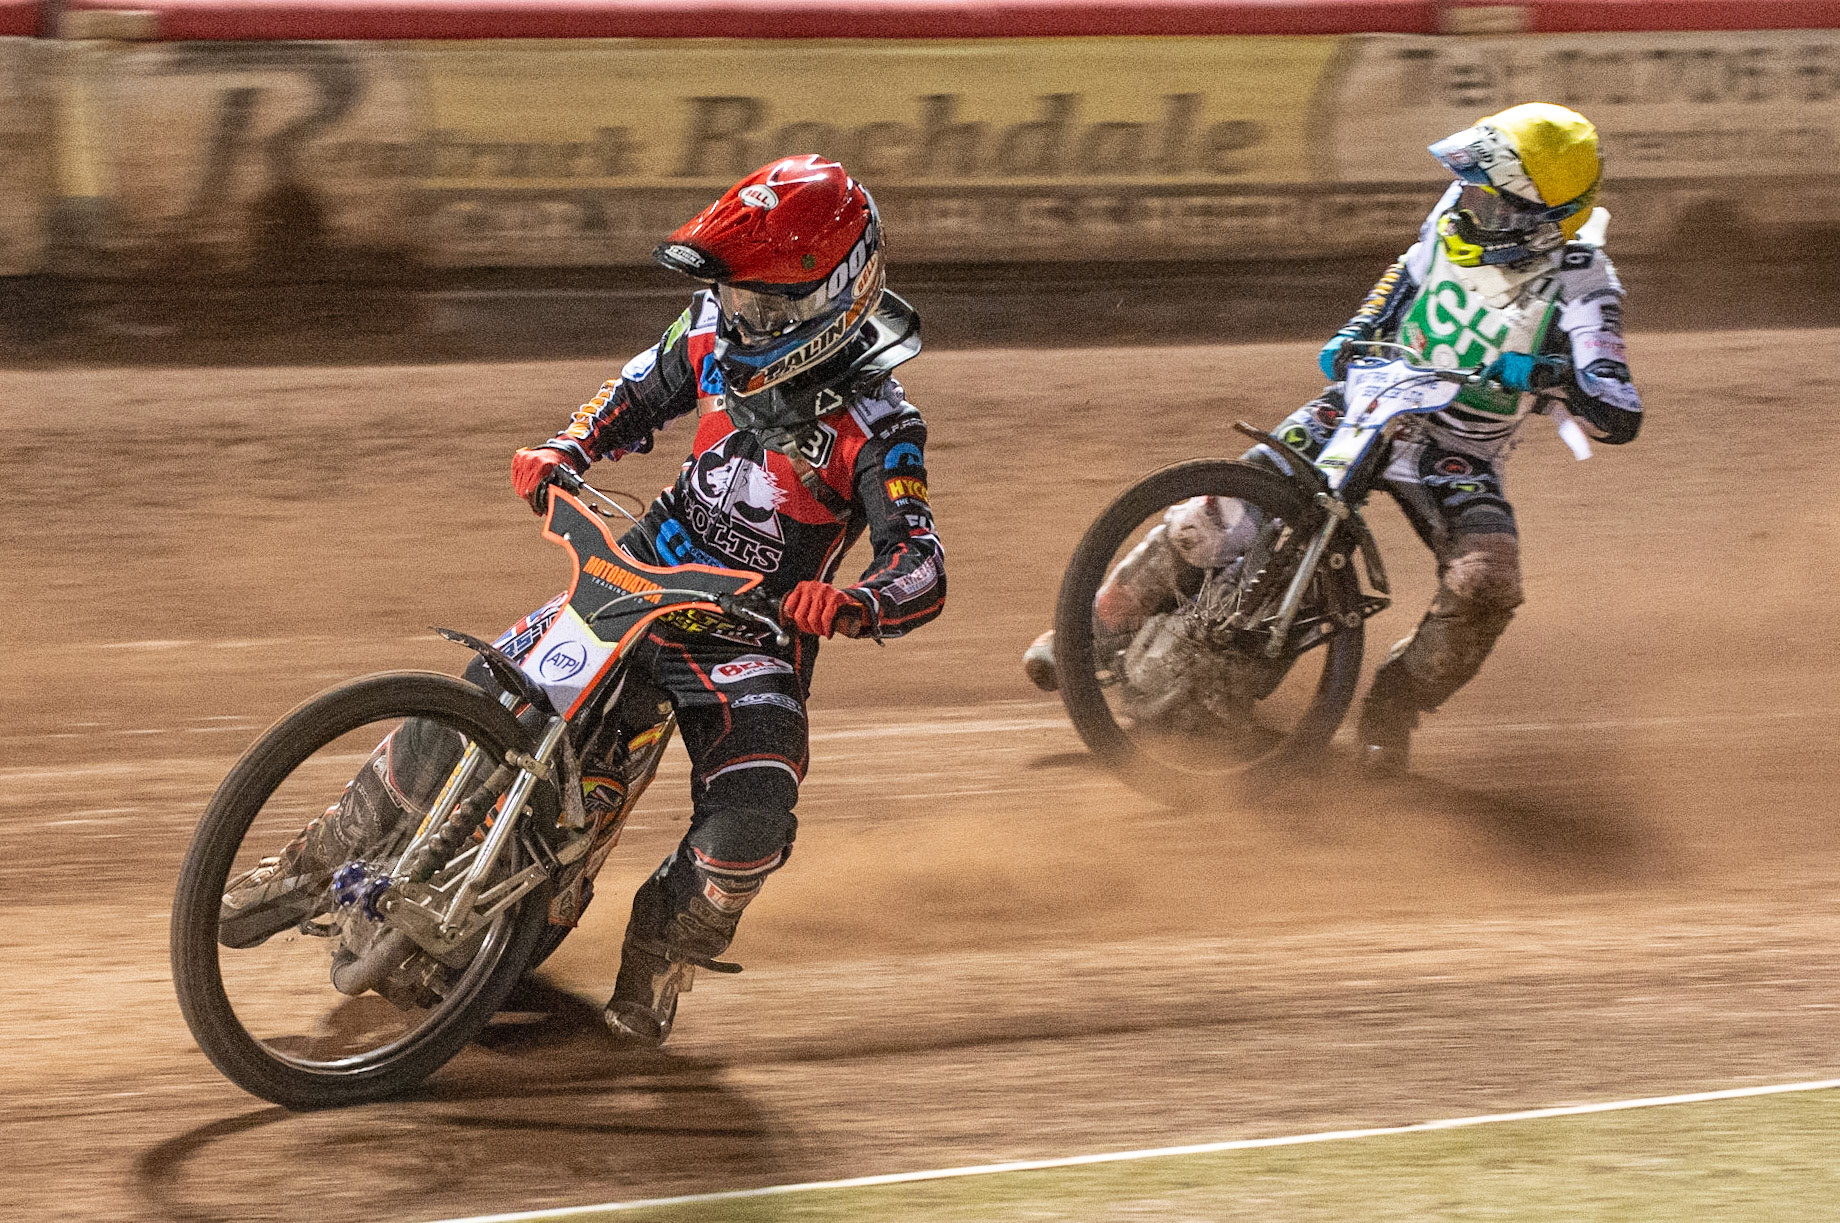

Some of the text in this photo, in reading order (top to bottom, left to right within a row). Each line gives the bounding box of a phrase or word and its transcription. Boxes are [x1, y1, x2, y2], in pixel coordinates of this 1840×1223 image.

[763, 312, 847, 384] PALIN
[583, 554, 666, 605] MOTORVATION
[546, 651, 580, 673] ATPI
